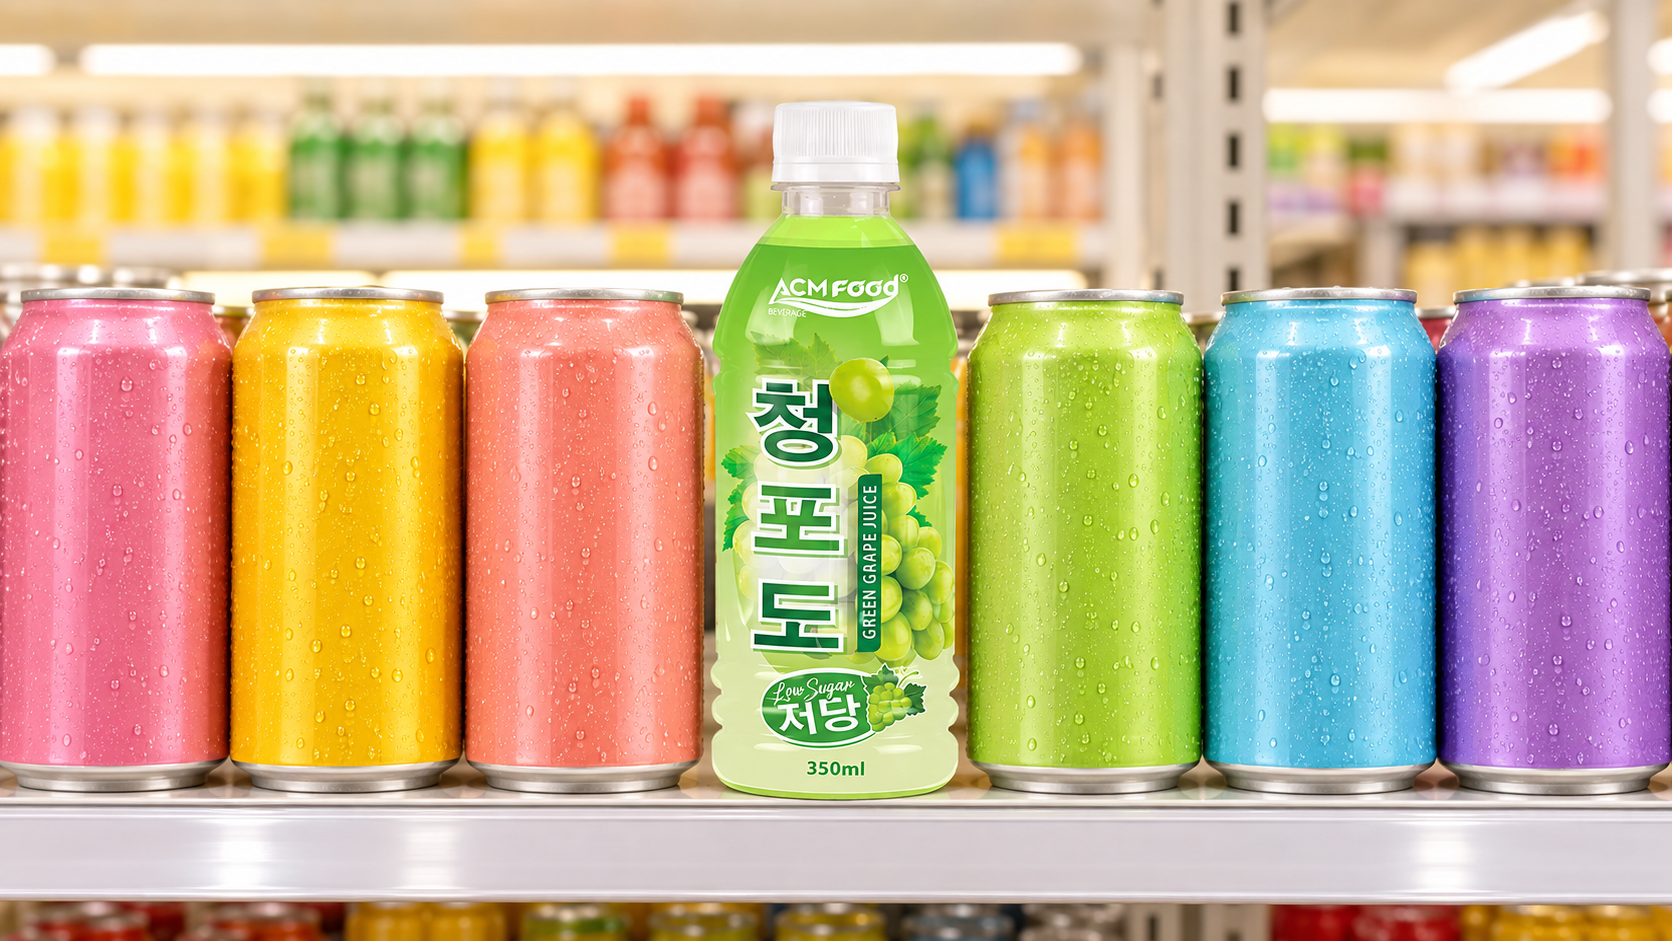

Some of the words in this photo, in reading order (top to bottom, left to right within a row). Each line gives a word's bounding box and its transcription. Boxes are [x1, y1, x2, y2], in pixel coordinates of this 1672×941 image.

[768, 307, 807, 318] BEVERAGE
[862, 485, 877, 528] JUICE
[862, 533, 877, 584] GRAPE
[862, 590, 877, 639] GREEN
[773, 682, 804, 705] Low
[804, 677, 855, 701] Sugar
[777, 694, 861, 735] 저당
[806, 761, 865, 776] 350ml
